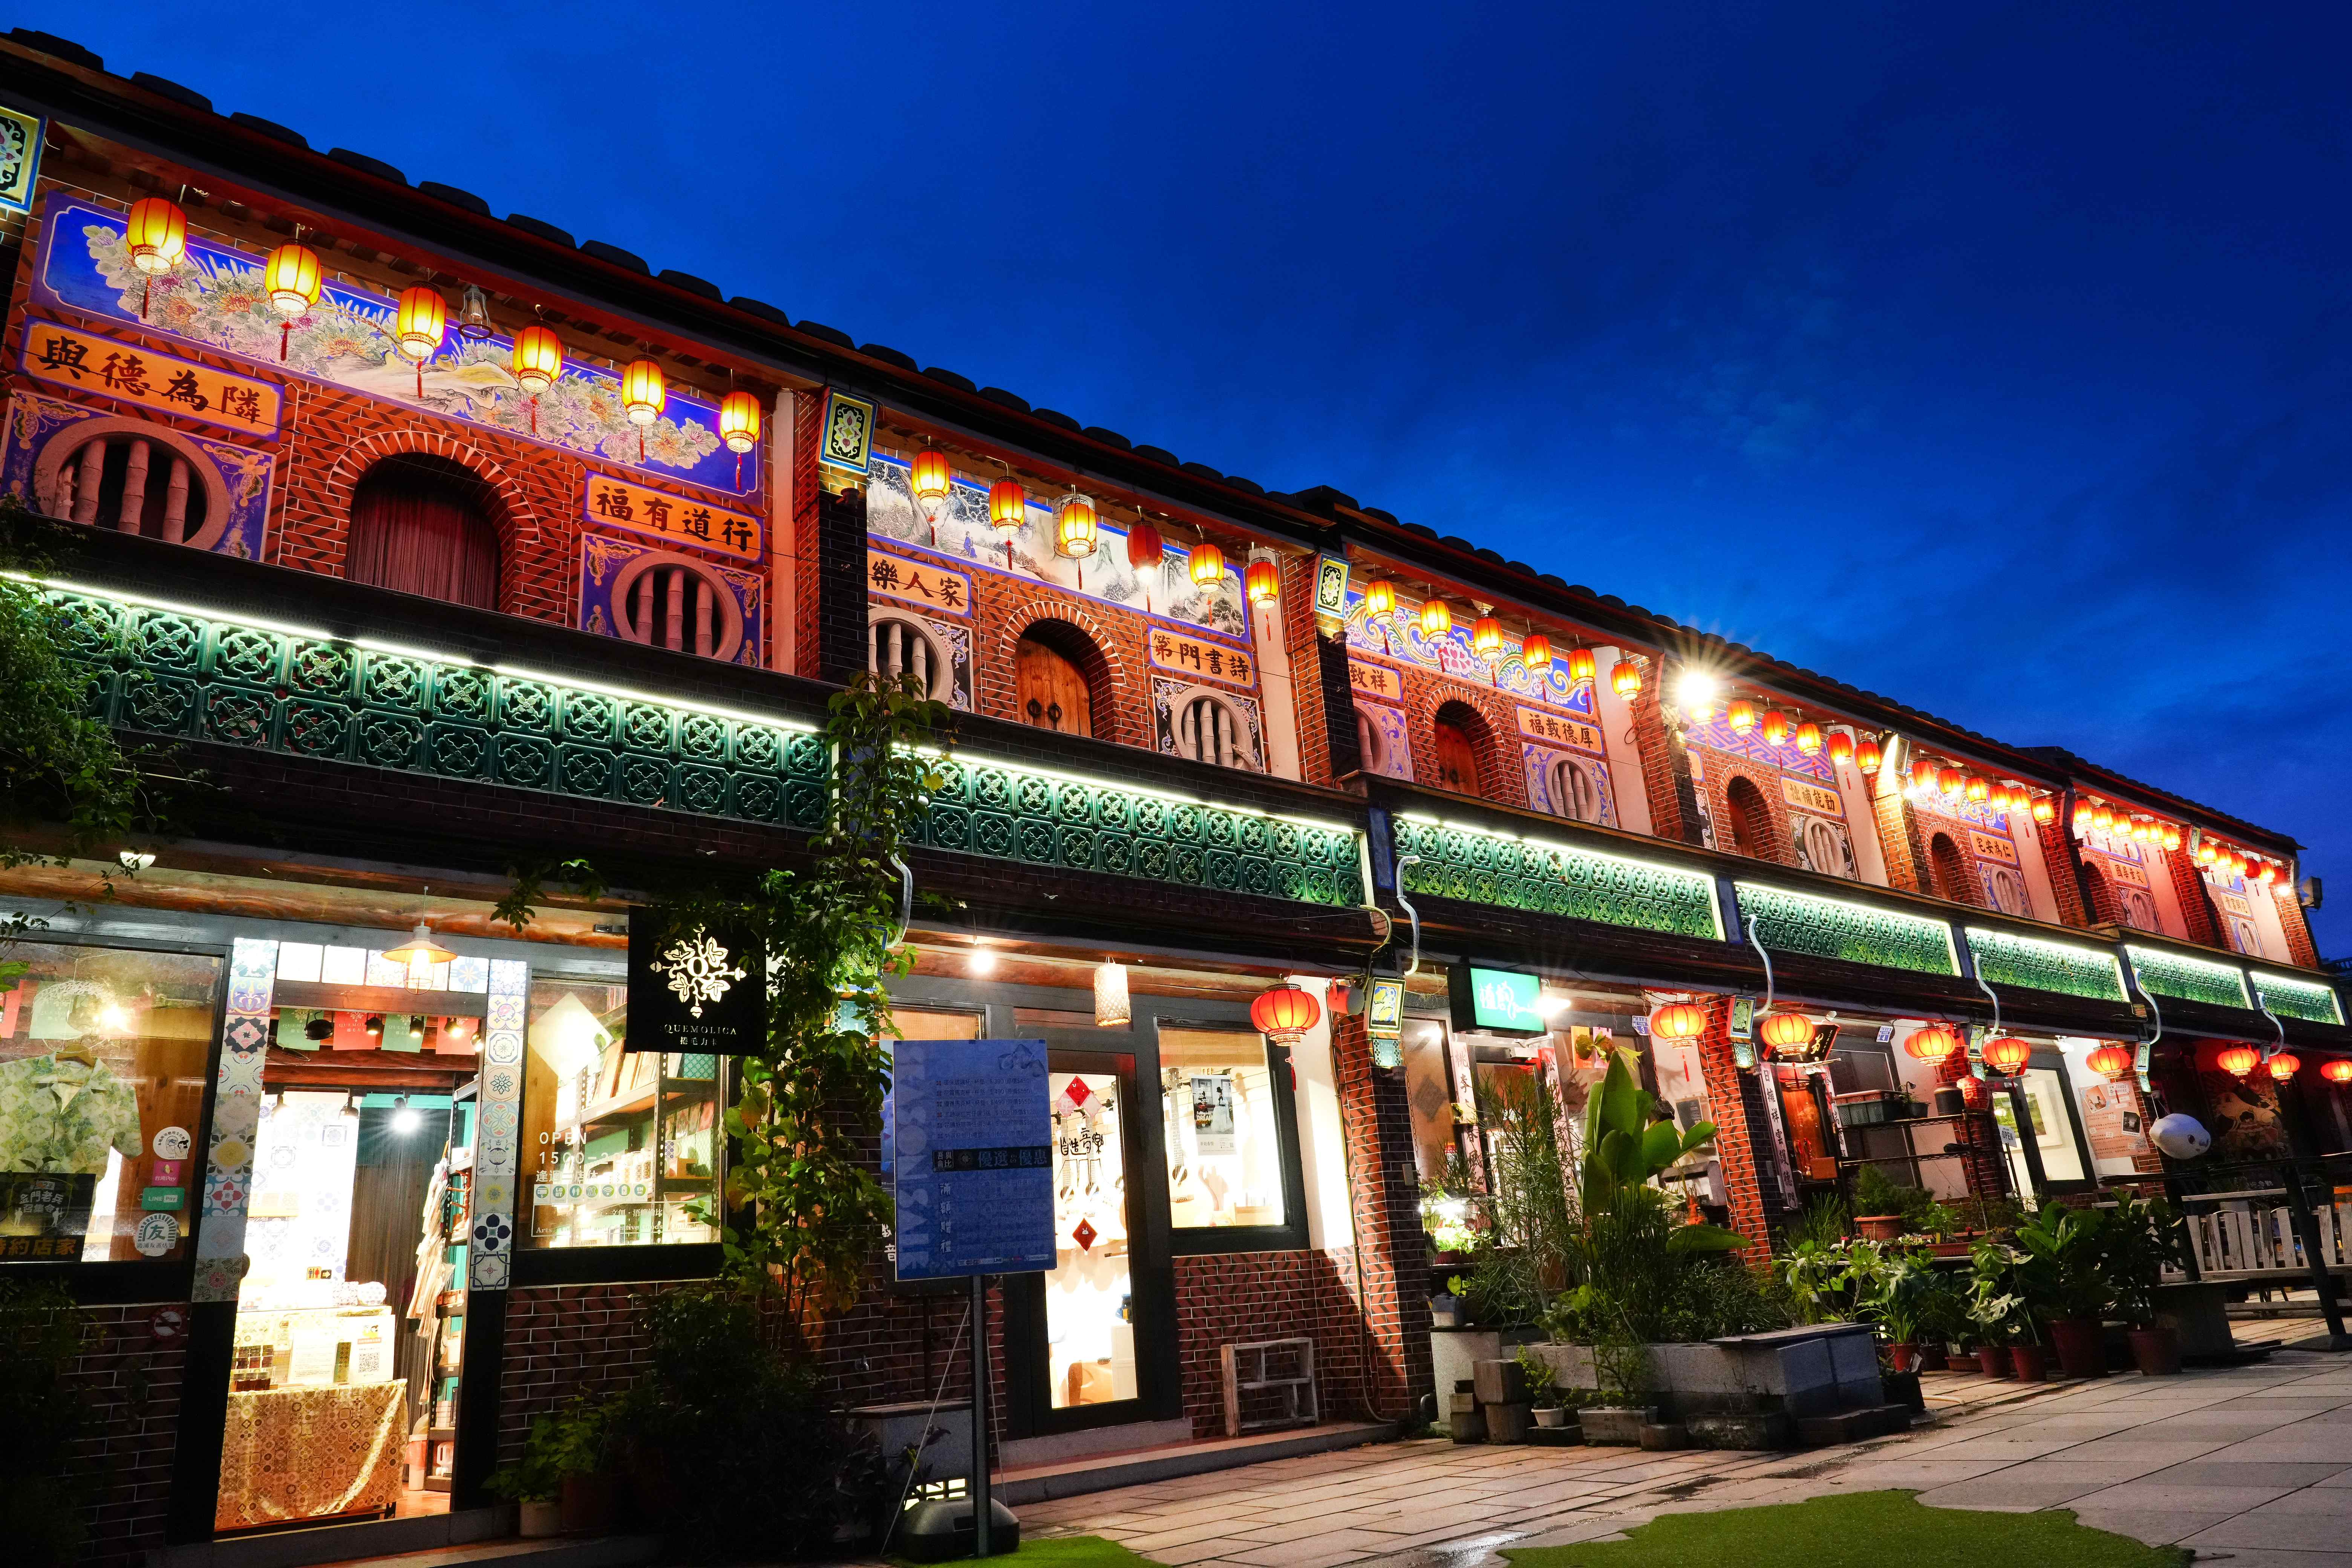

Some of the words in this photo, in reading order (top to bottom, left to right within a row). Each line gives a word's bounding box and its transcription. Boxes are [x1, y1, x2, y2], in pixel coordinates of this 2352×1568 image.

[664, 1024, 737, 1035] QUEMOLICA
[539, 1132, 586, 1145] OPEN
[2002, 1130, 2014, 1141] OPEN
[19, 1190, 64, 1205] 金門老兵
[23, 1204, 55, 1213] 召集令
[147, 1224, 166, 1240] 友
